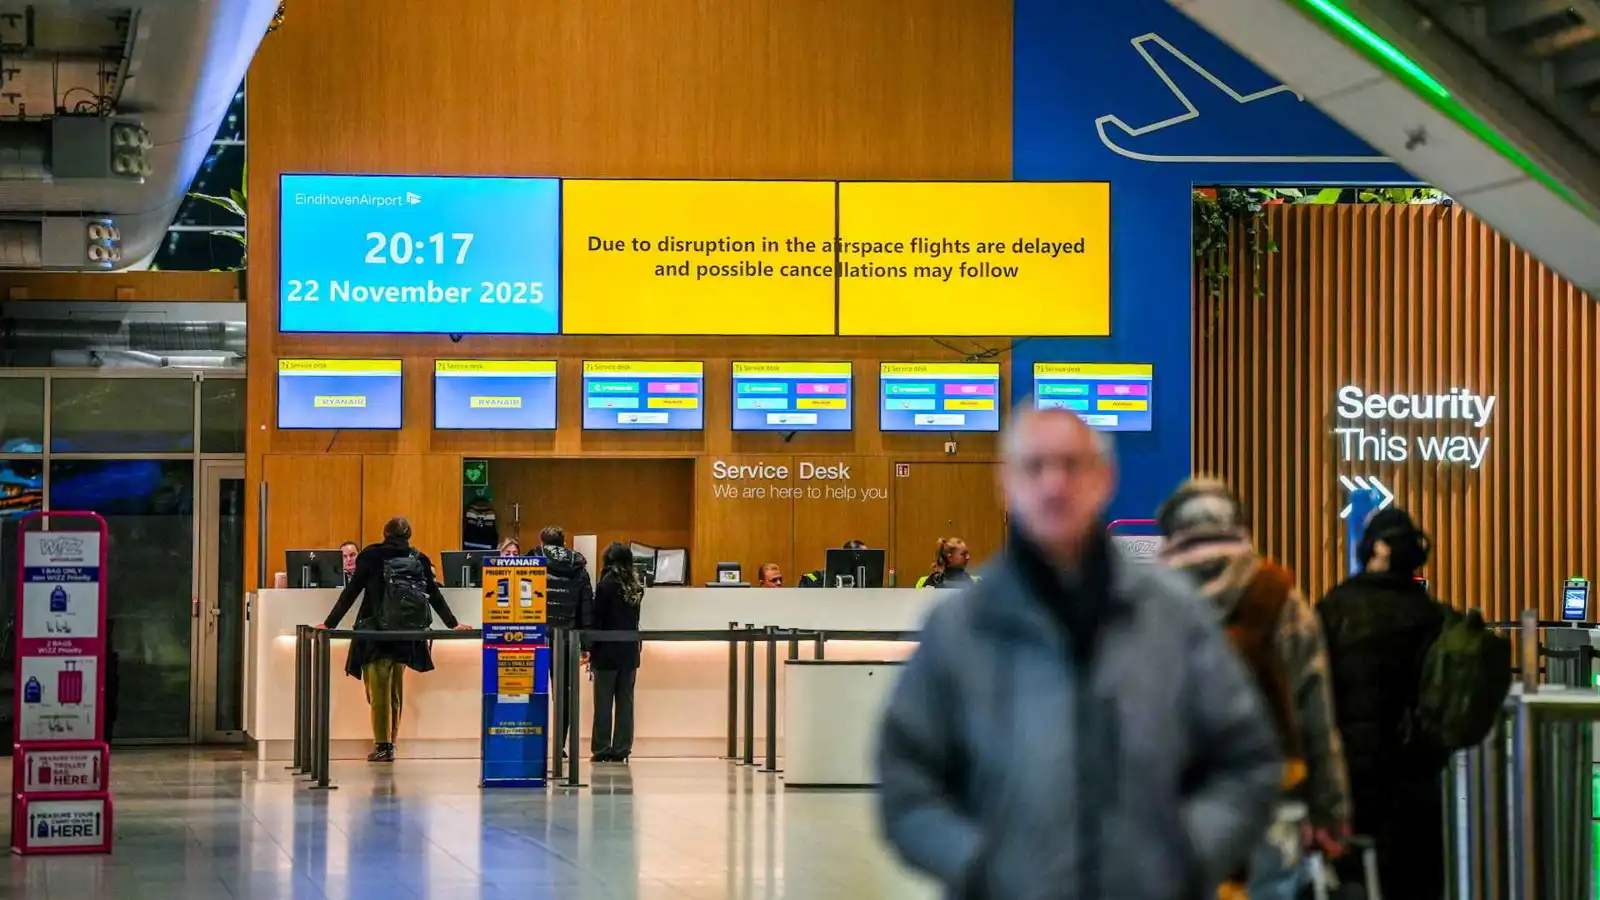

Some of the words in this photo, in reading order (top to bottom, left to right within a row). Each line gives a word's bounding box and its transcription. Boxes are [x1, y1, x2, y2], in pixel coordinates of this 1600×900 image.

[364, 232, 474, 264] 20:17
[588, 236, 625, 251] Due
[632, 237, 651, 252] to
[658, 236, 755, 256] disruption
[762, 237, 779, 252] in
[785, 236, 816, 252] the
[822, 238, 904, 257] airspace
[910, 238, 970, 257] flights
[976, 240, 1005, 254] are
[1012, 238, 1085, 257] delayed
[654, 260, 690, 276] and
[696, 260, 773, 280] possible
[780, 262, 907, 278] cancellations
[914, 265, 953, 282] may
[958, 262, 1018, 278] follow
[287, 280, 320, 302] 22
[330, 280, 472, 304] November
[480, 282, 544, 304] 2025
[1336, 386, 1496, 428] Security
[1334, 428, 1408, 461] This
[1416, 436, 1490, 468] way
[712, 460, 788, 480] Service
[799, 462, 851, 480] Desk
[713, 484, 738, 498] We
[742, 486, 765, 498] are
[770, 485, 802, 499] here
[808, 486, 822, 499] to
[826, 486, 856, 502] help
[860, 488, 888, 502] you
[54, 775, 88, 785] HERE
[51, 825, 93, 837] HERE
